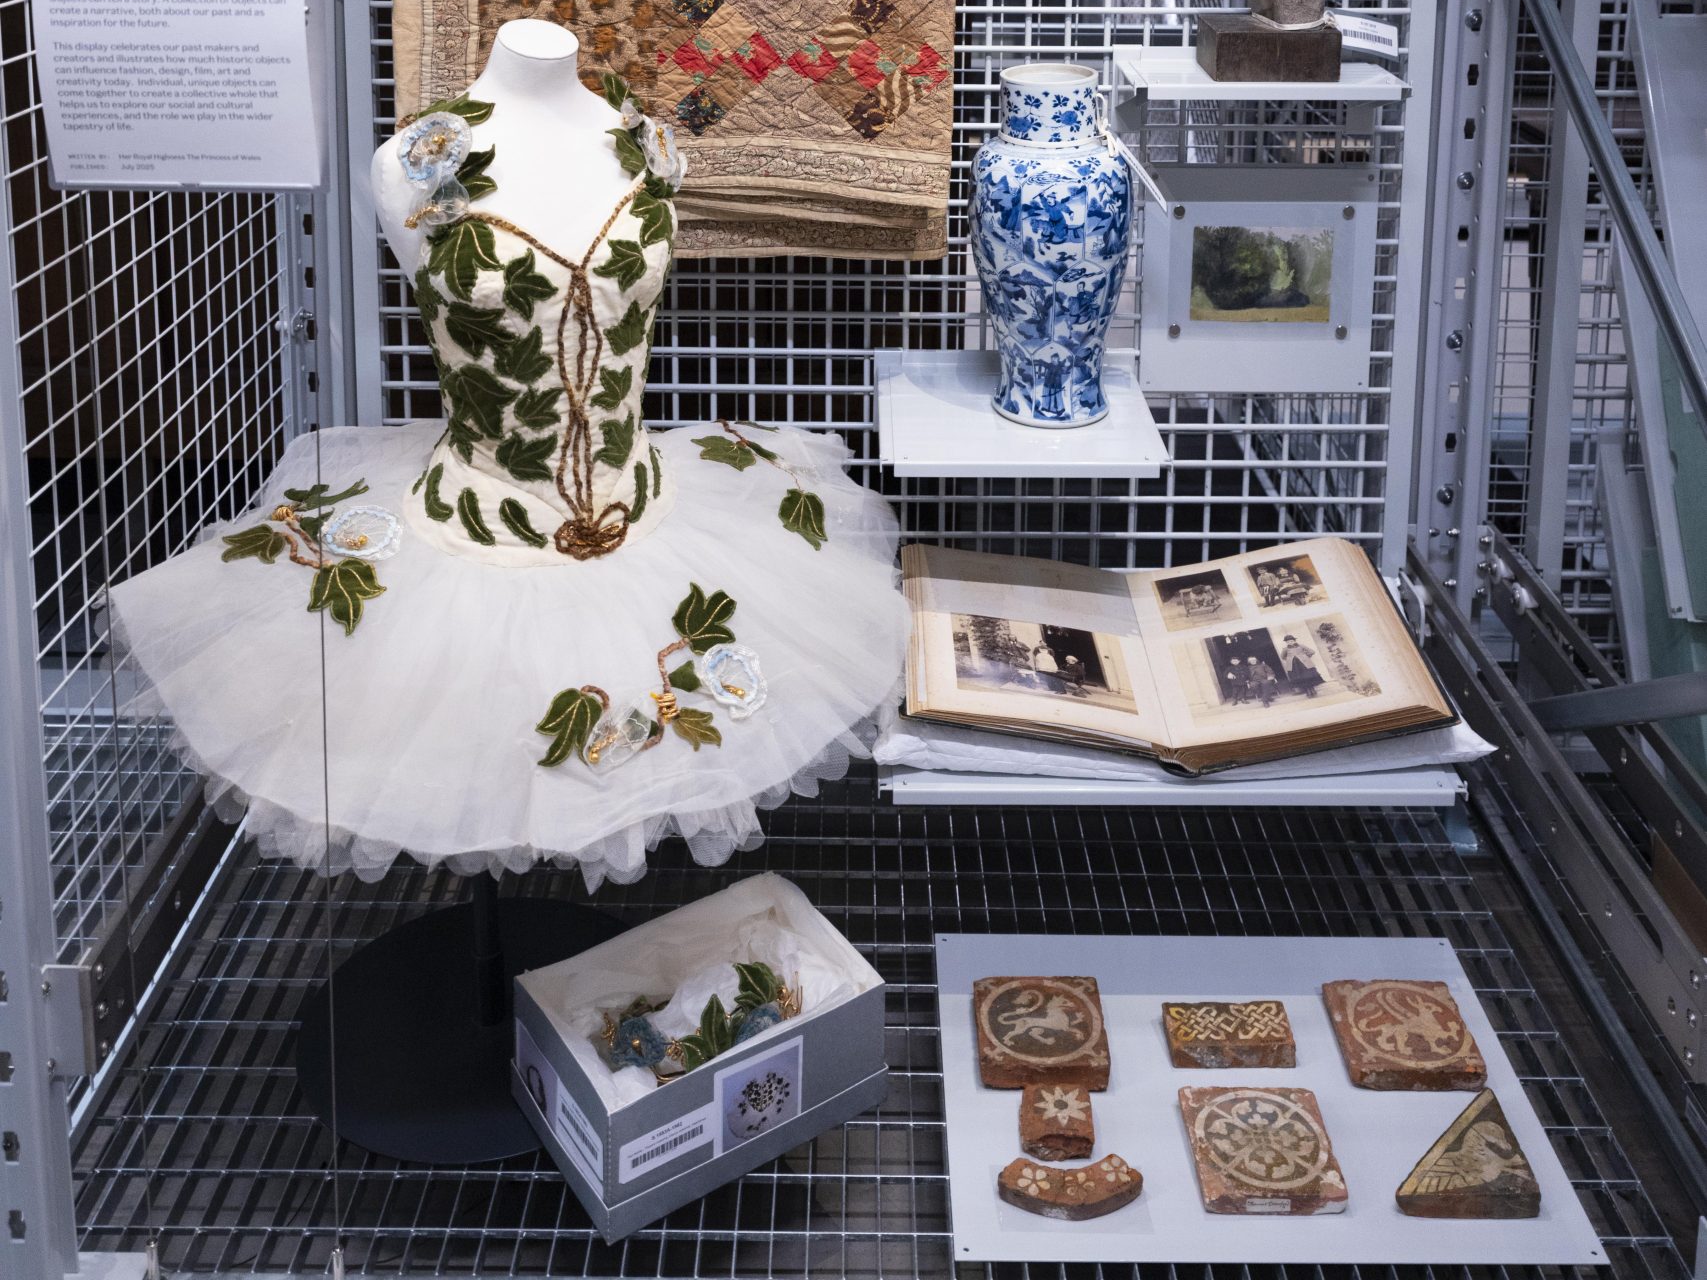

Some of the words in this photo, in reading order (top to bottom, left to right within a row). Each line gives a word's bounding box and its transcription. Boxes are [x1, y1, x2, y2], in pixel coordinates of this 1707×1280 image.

[49, 6, 81, 14] create
[90, 6, 137, 16] narrative,
[138, 6, 161, 15] both
[163, 8, 190, 16] about
[193, 8, 209, 16] our
[211, 8, 232, 17] past
[234, 8, 252, 16] and
[50, 18, 102, 27] inspiration
[103, 18, 117, 27] for
[119, 18, 136, 27] the
[137, 18, 170, 28] future.
[53, 42, 73, 51] This
[74, 42, 108, 52] display
[110, 42, 161, 51] celebrates
[181, 44, 202, 53] past
[204, 44, 240, 52] makers
[242, 44, 260, 52] and
[53, 54, 95, 63] creators
[96, 54, 114, 63] and
[116, 54, 164, 63] illustrates
[166, 55, 186, 63] how
[188, 55, 214, 63] much
[216, 55, 254, 64] historic
[255, 56, 291, 65] objects
[73, 65, 117, 74] influence
[119, 66, 157, 76] fashion,
[158, 66, 193, 76] design,
[194, 67, 215, 76] film,
[233, 67, 251, 75] and
[56, 78, 102, 87] creativity
[104, 78, 134, 87] today.
[137, 78, 187, 88] Individual,
[188, 79, 220, 88] unique
[222, 78, 257, 88] objects
[85, 89, 127, 99] together
[129, 89, 139, 97] to
[141, 89, 172, 98] create
[181, 90, 227, 98] collective
[229, 90, 257, 98] whole
[259, 90, 279, 98] that
[59, 100, 85, 110] helps
[100, 101, 110, 109] to
[112, 101, 148, 110] explore
[150, 101, 165, 109] our
[168, 101, 195, 109] social
[197, 101, 215, 109] and
[216, 101, 253, 109] cultural
[61, 112, 122, 121] experiences,
[123, 112, 141, 120] and
[143, 112, 159, 120] the
[160, 112, 179, 120] role
[197, 112, 216, 122] play
[228, 112, 245, 121] the
[246, 113, 273, 121] wider
[63, 123, 103, 132] tapestry
[105, 122, 115, 131] of
[117, 122, 134, 131] life.
[153, 153, 185, 161] Highness
